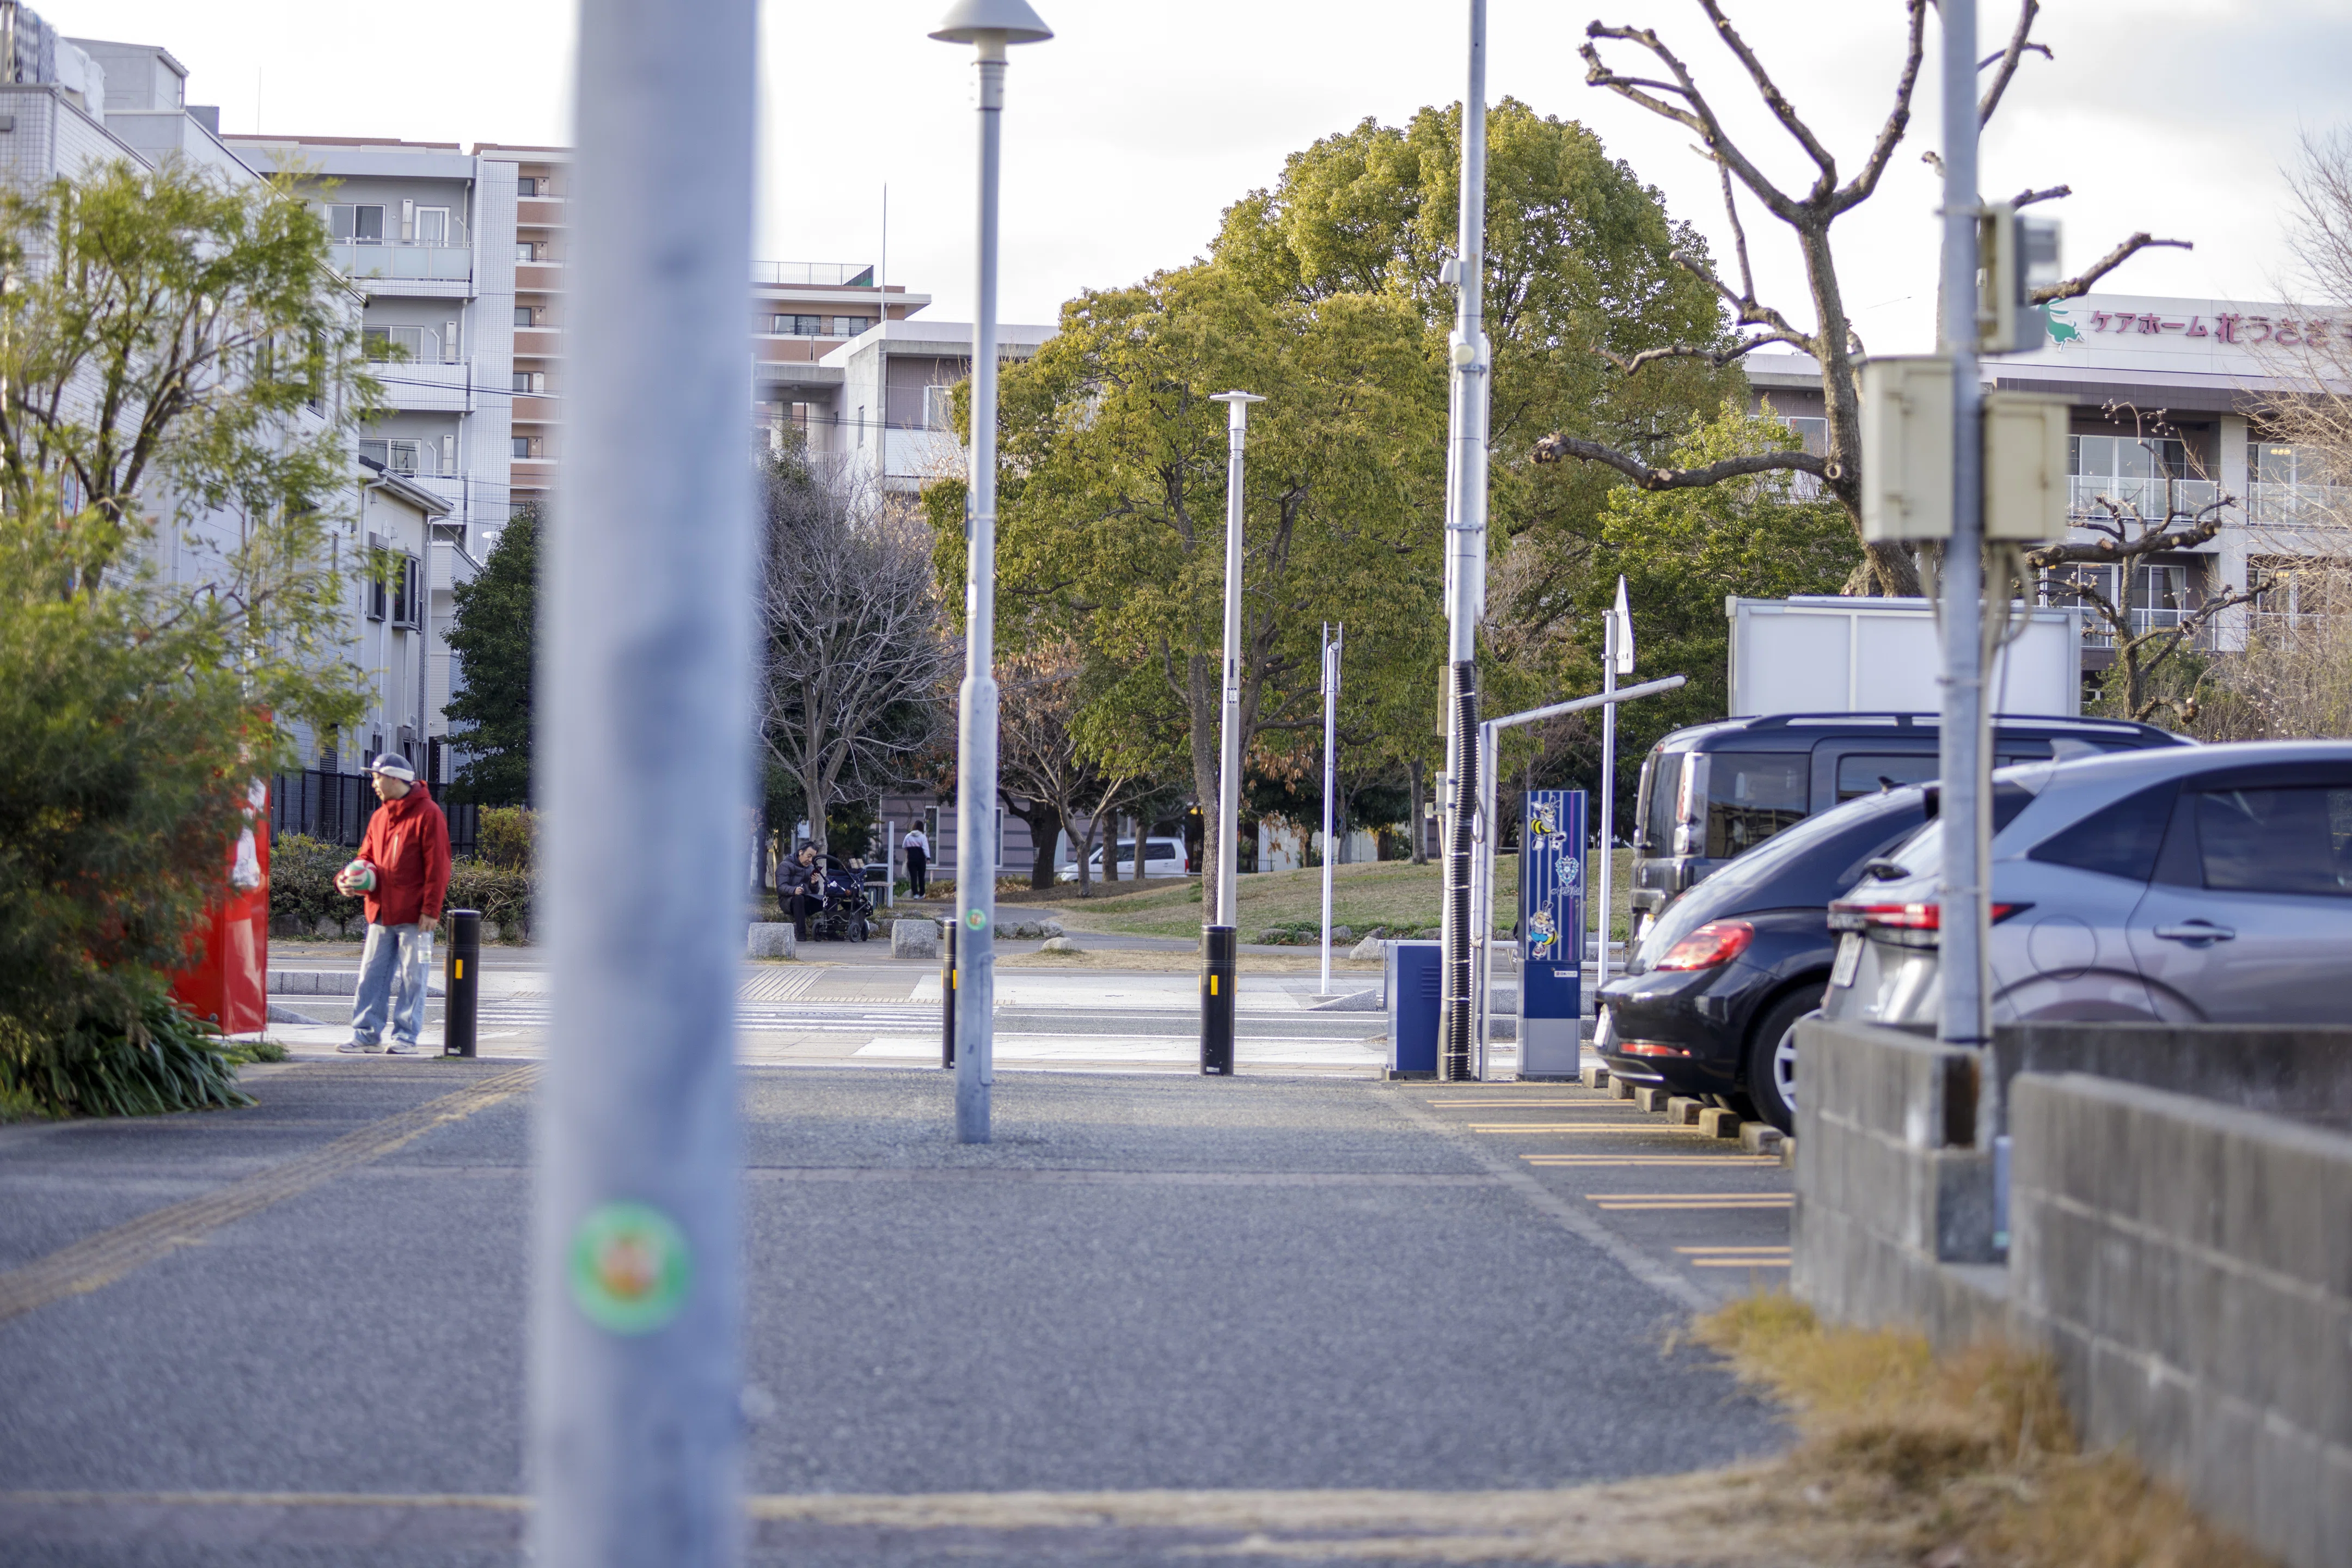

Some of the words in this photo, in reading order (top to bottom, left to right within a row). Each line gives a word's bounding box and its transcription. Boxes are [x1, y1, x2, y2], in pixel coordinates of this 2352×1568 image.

[2090, 310, 2352, 347] ケアホーム花うさぎ
